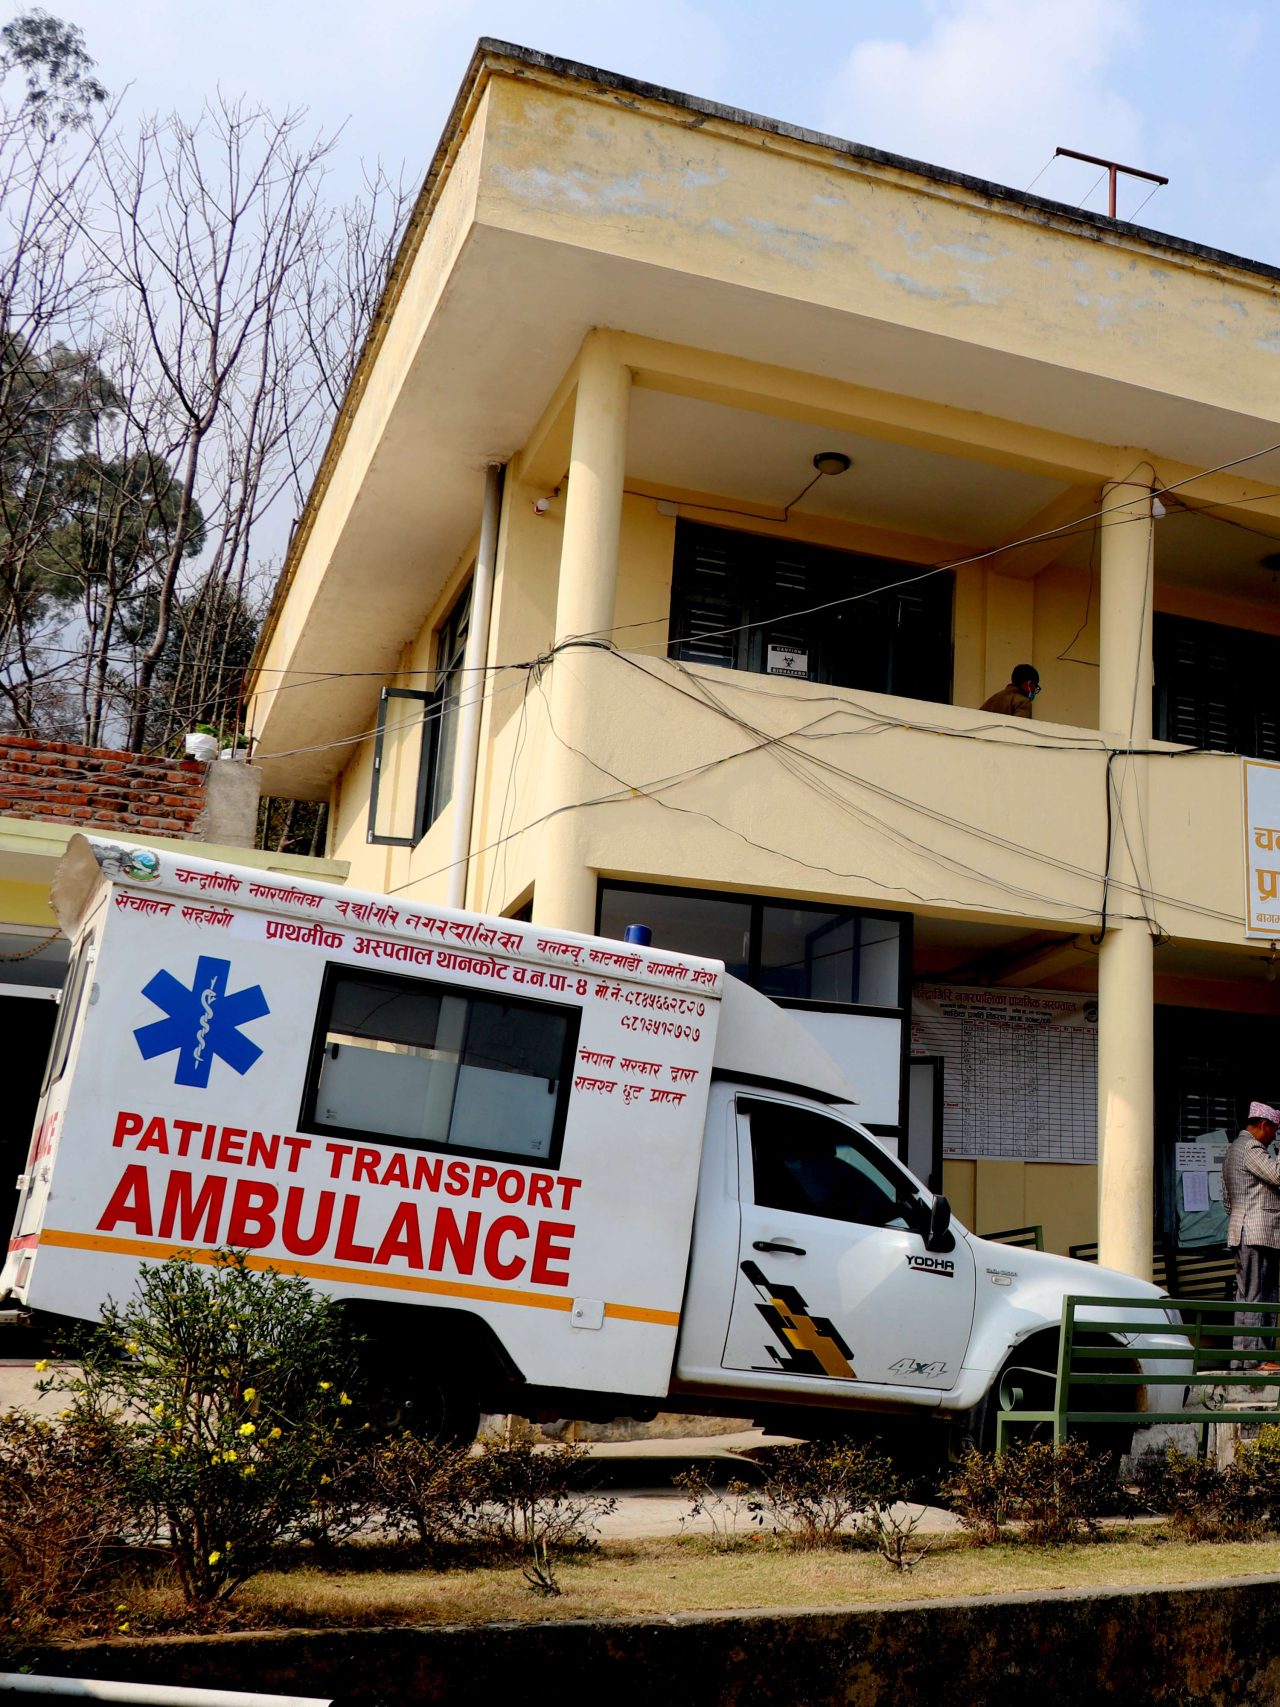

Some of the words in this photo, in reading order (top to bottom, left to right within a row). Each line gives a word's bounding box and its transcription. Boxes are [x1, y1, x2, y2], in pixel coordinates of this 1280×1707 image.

[115, 891, 175, 917] संचालन
[182, 903, 235, 929] सहयोगी
[249, 883, 324, 909] नगरपालिका
[690, 967, 718, 987] प्रदेश
[266, 920, 345, 949] प्राथमीक
[353, 936, 434, 965] अस्पताल
[435, 951, 510, 980] थानकोट
[578, 1046, 616, 1069] नेपाल
[620, 1057, 663, 1080] सरकार
[670, 1066, 699, 1084] द्वारा
[649, 1088, 687, 1109] प्राप्त
[112, 1111, 312, 1173] PATIENT
[325, 1143, 582, 1211] TRANSPORT
[96, 1164, 576, 1287] AMBULANCE
[905, 1254, 954, 1271] YODHA
[888, 1358, 949, 1378] 4x4
